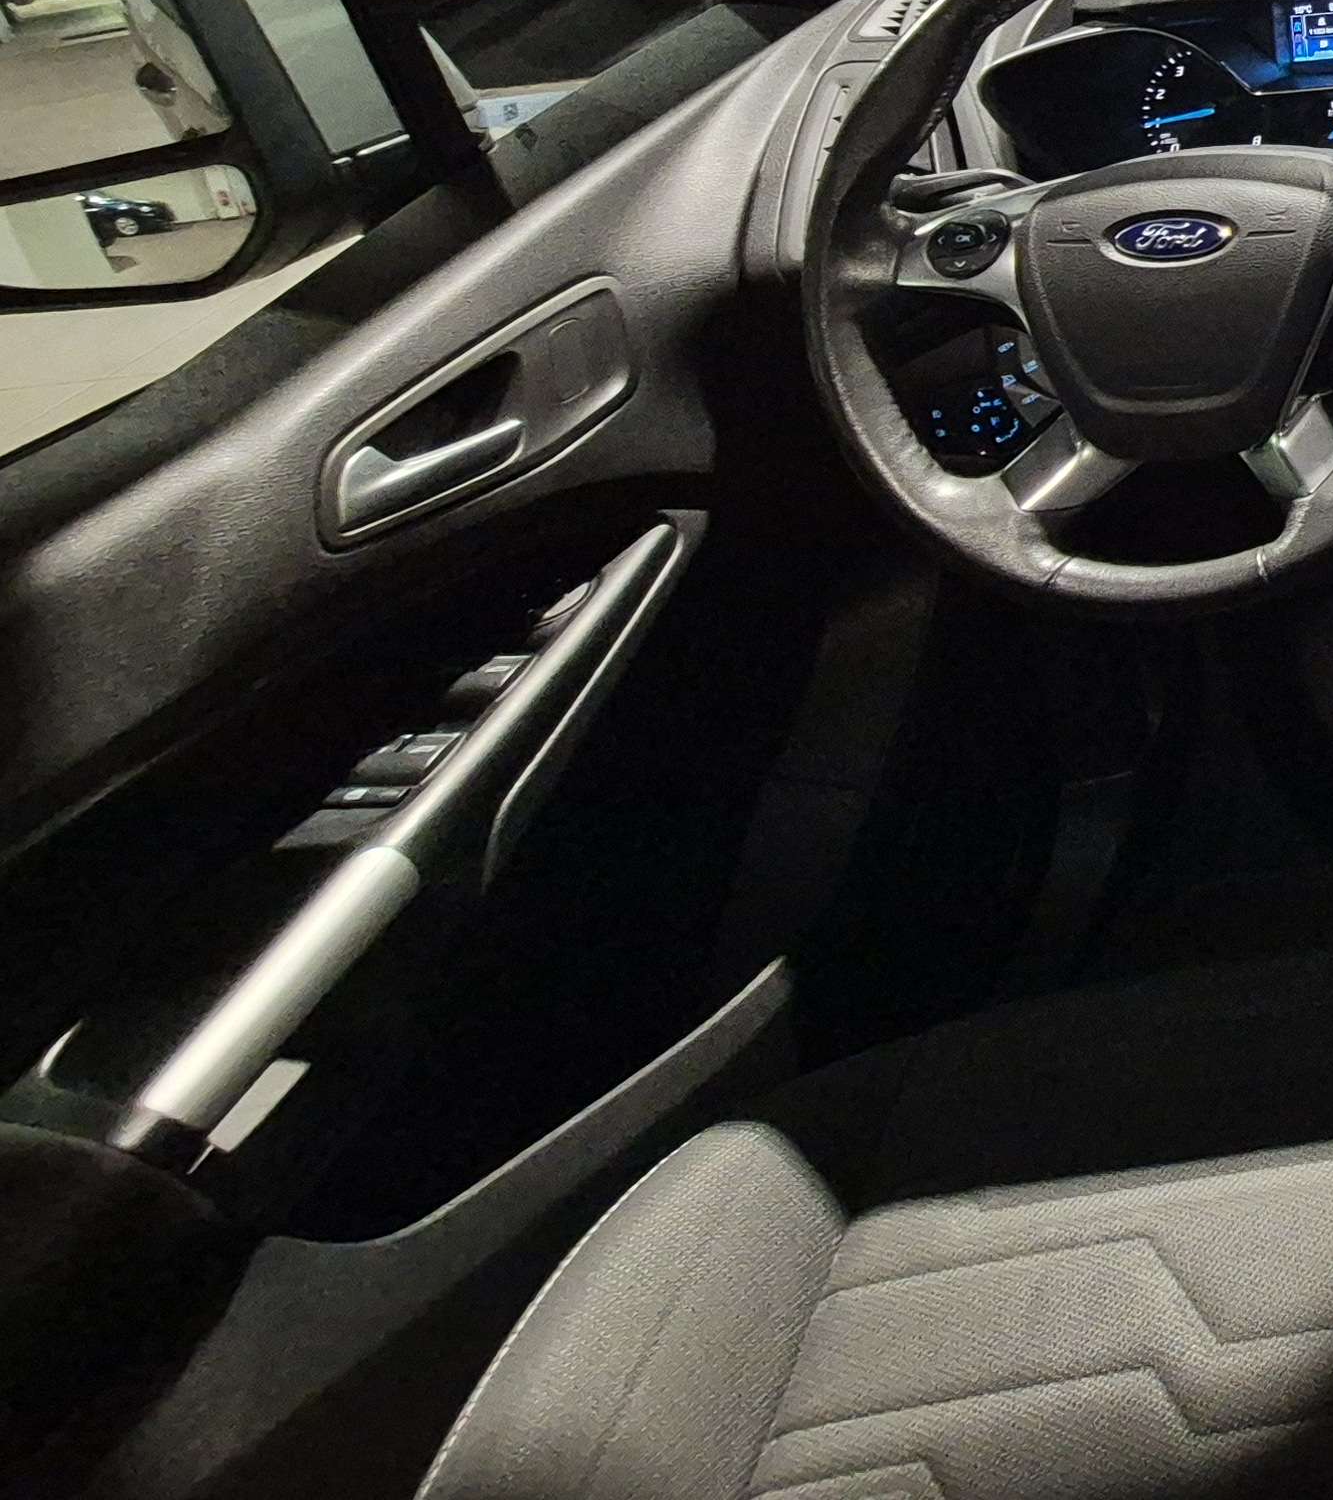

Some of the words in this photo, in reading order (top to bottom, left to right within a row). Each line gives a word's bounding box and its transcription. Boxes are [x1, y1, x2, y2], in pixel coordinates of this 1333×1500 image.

[1175, 65, 1185, 77] 3
[1155, 88, 1166, 100] 2
[1136, 223, 1207, 248] Ford
